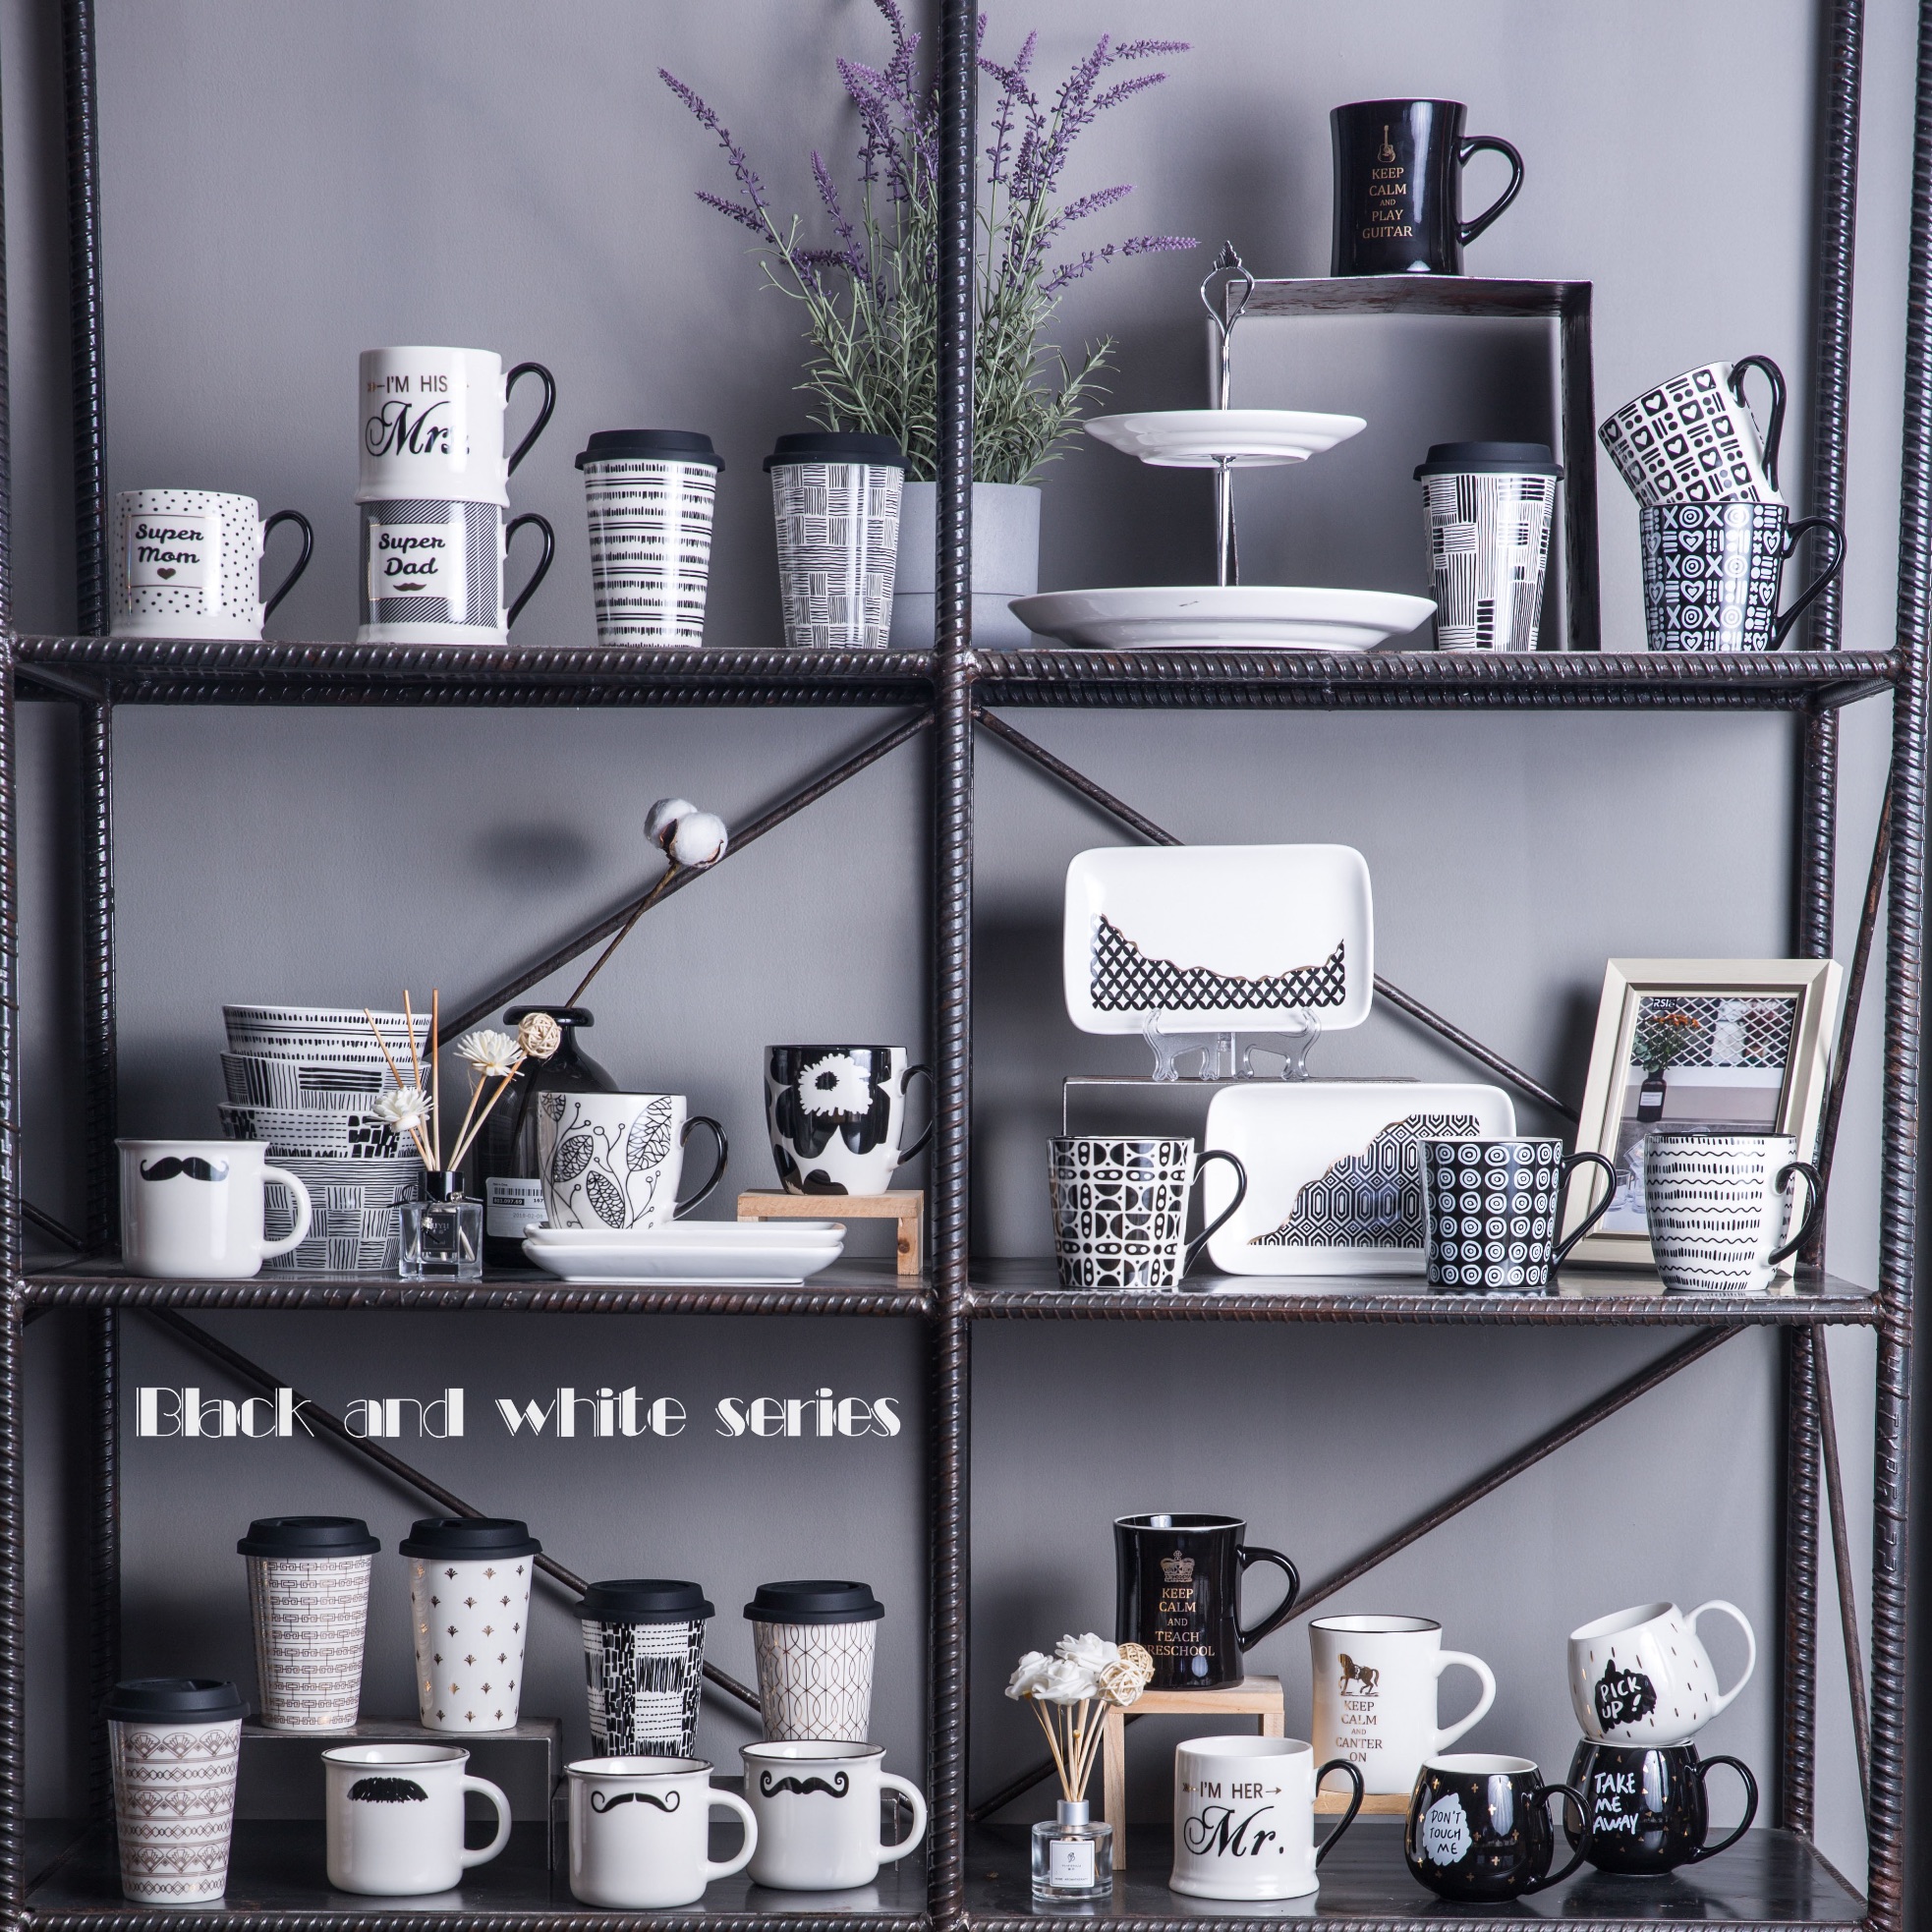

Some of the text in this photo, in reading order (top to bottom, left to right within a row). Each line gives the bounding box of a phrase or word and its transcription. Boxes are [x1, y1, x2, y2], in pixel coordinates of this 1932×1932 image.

[1372, 167, 1404, 180] KEEP
[1369, 184, 1407, 197] CALM
[1372, 209, 1403, 222] PLAY
[1362, 226, 1413, 239] GUITAR
[386, 375, 448, 393] I'M HIS
[135, 523, 203, 546] Super
[378, 532, 445, 555] Super
[138, 546, 199, 564] Mom
[383, 557, 438, 576] Dad
[1162, 1588, 1194, 1599] KEEP
[1159, 1601, 1196, 1613] CALM
[1166, 1618, 1188, 1626] AND
[1155, 1630, 1200, 1643] TEACH
[1600, 1676, 1642, 1702] PICK
[1343, 1700, 1375, 1712] KEEP
[1341, 1714, 1377, 1726] CALM
[1335, 1736, 1383, 1749] CANTER
[1349, 1751, 1367, 1762] ON
[1594, 1772, 1636, 1794] TAKE
[1200, 1782, 1263, 1799] I'M HER
[1595, 1797, 1622, 1813] ME
[1431, 1809, 1461, 1825] DON'T
[1183, 1805, 1284, 1857] Mr.
[1592, 1813, 1639, 1836] AWAY
[1430, 1827, 1461, 1840] TOUCH
[1437, 1843, 1458, 1854] ME
